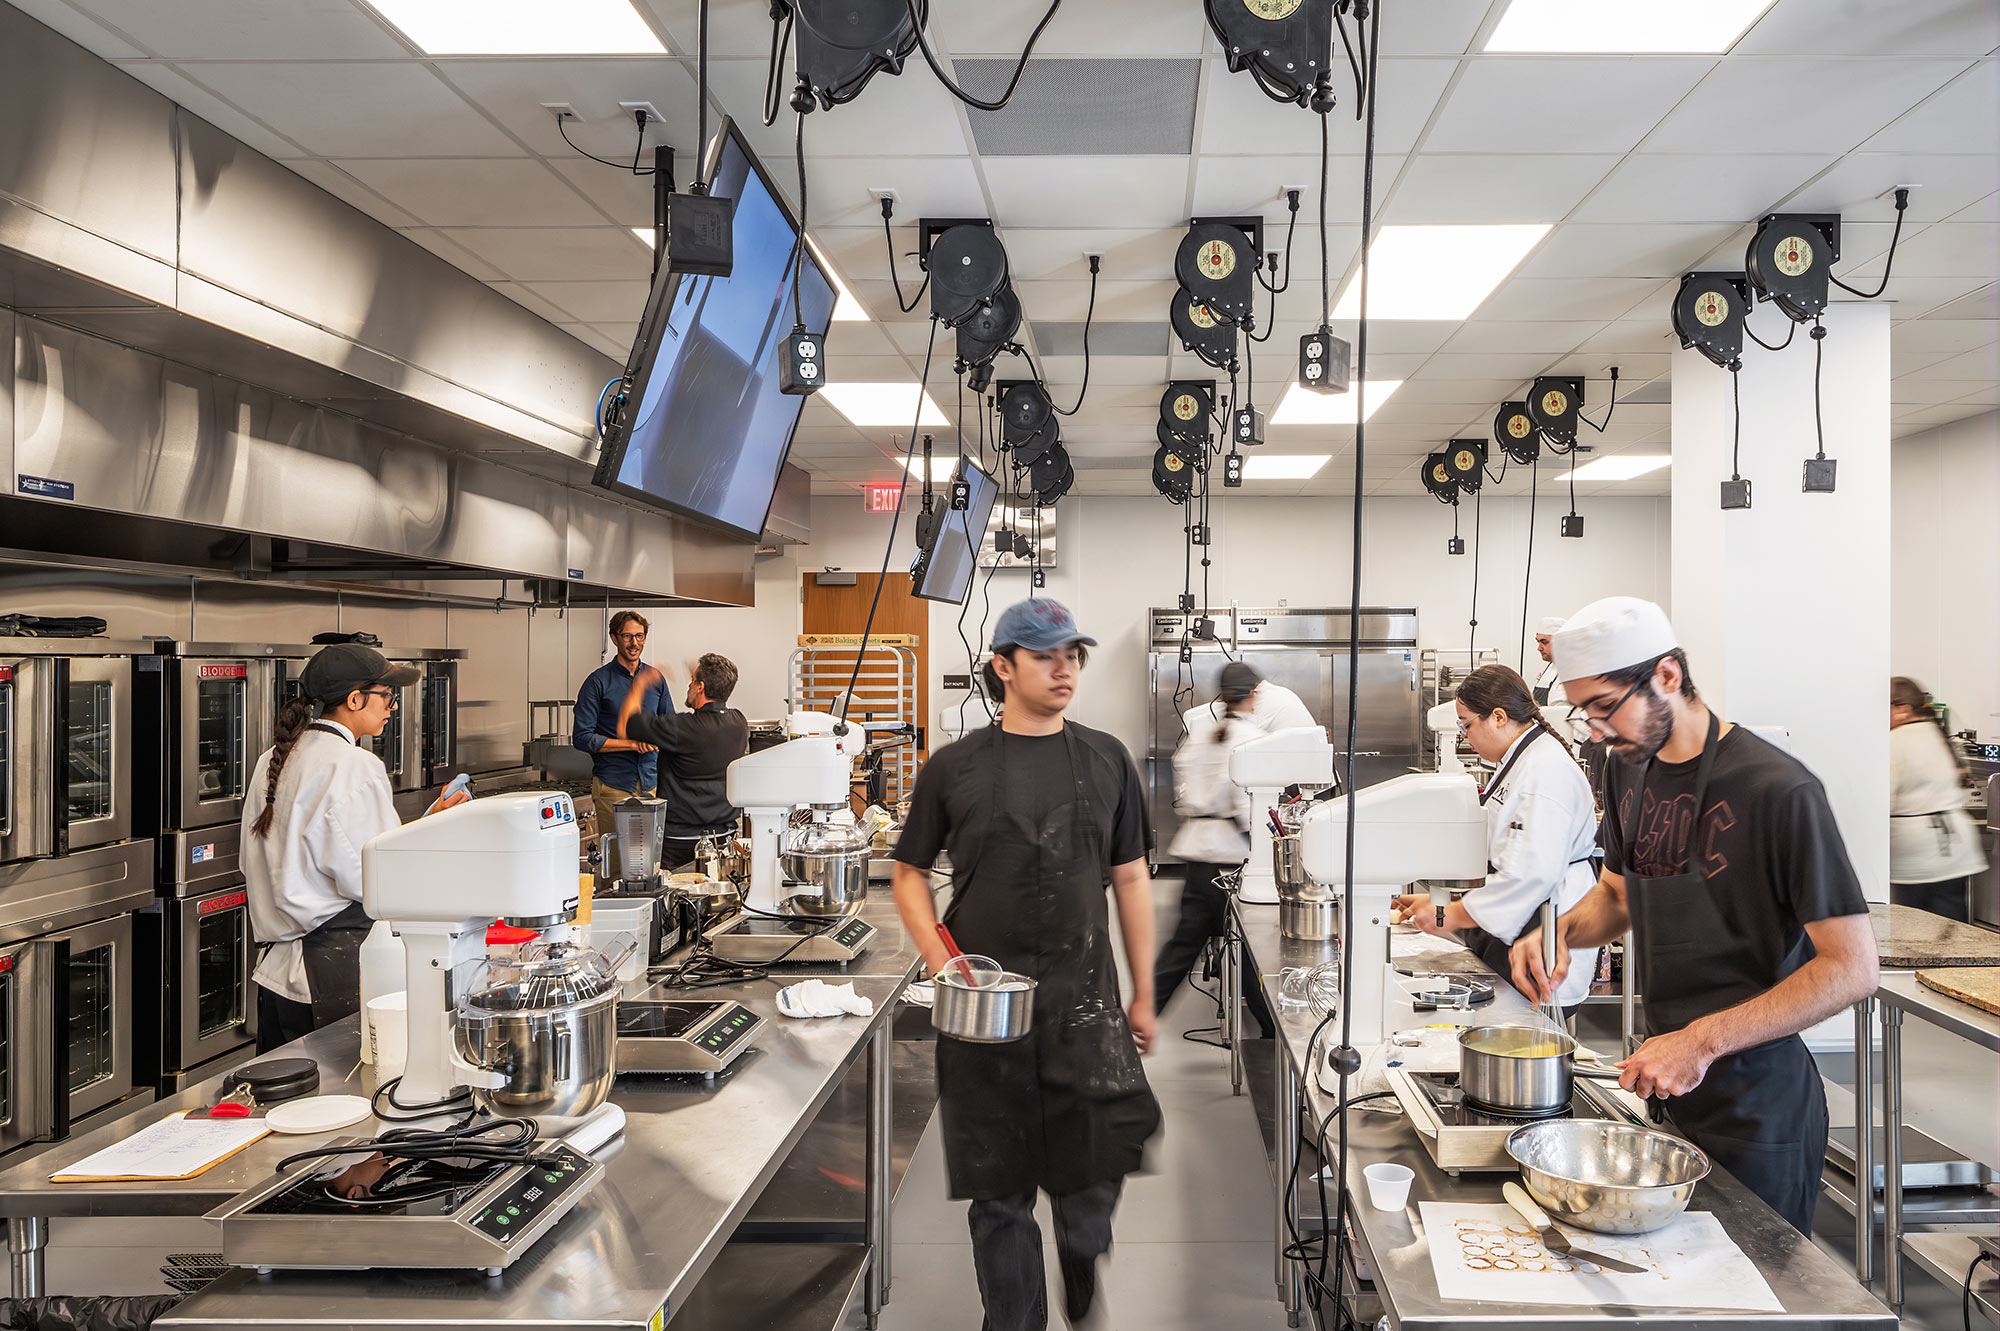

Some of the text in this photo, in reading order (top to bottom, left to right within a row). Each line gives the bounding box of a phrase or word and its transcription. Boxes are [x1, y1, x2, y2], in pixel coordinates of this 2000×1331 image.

[872, 488, 901, 511] EXIT
[835, 637, 858, 645] Baking
[202, 666, 245, 676] BLODGETT
[202, 893, 245, 913] BLODGETT
